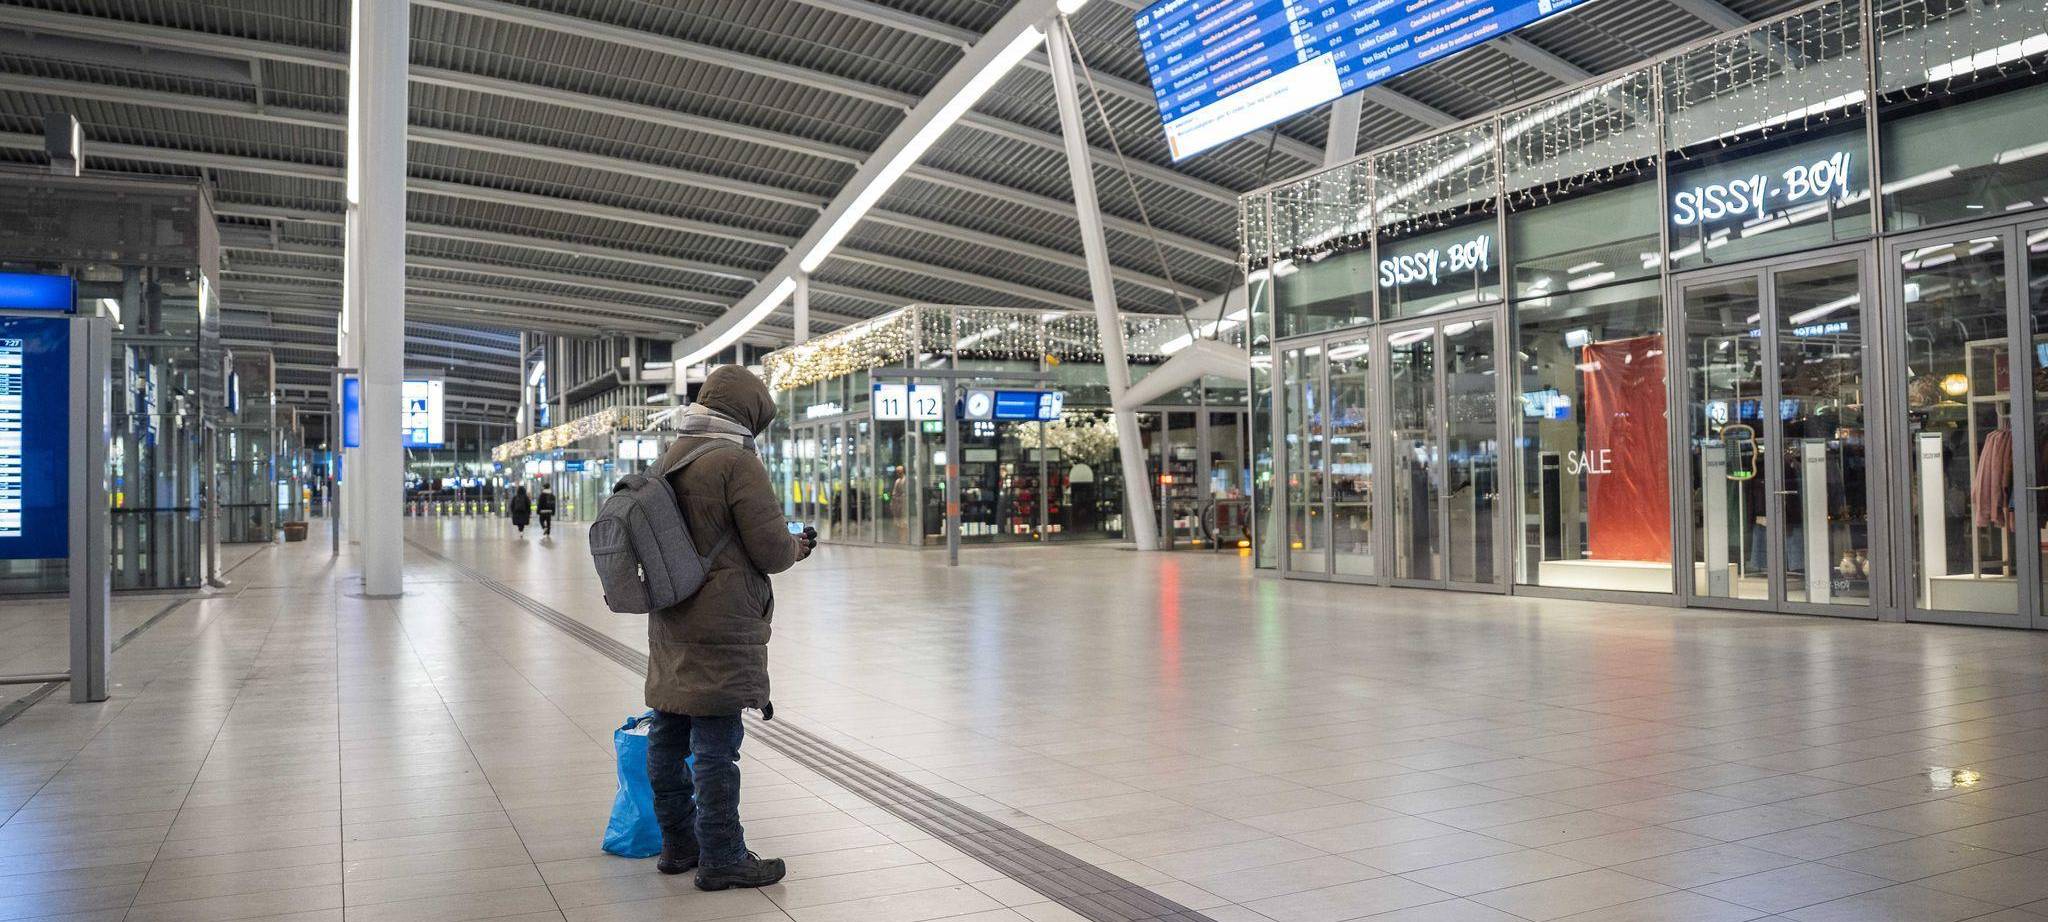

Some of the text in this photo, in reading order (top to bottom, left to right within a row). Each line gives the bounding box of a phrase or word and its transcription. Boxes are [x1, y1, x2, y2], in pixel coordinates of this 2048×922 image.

[882, 398, 898, 416] 11
[916, 398, 936, 416] 12
[1567, 449, 1612, 475] SALE
